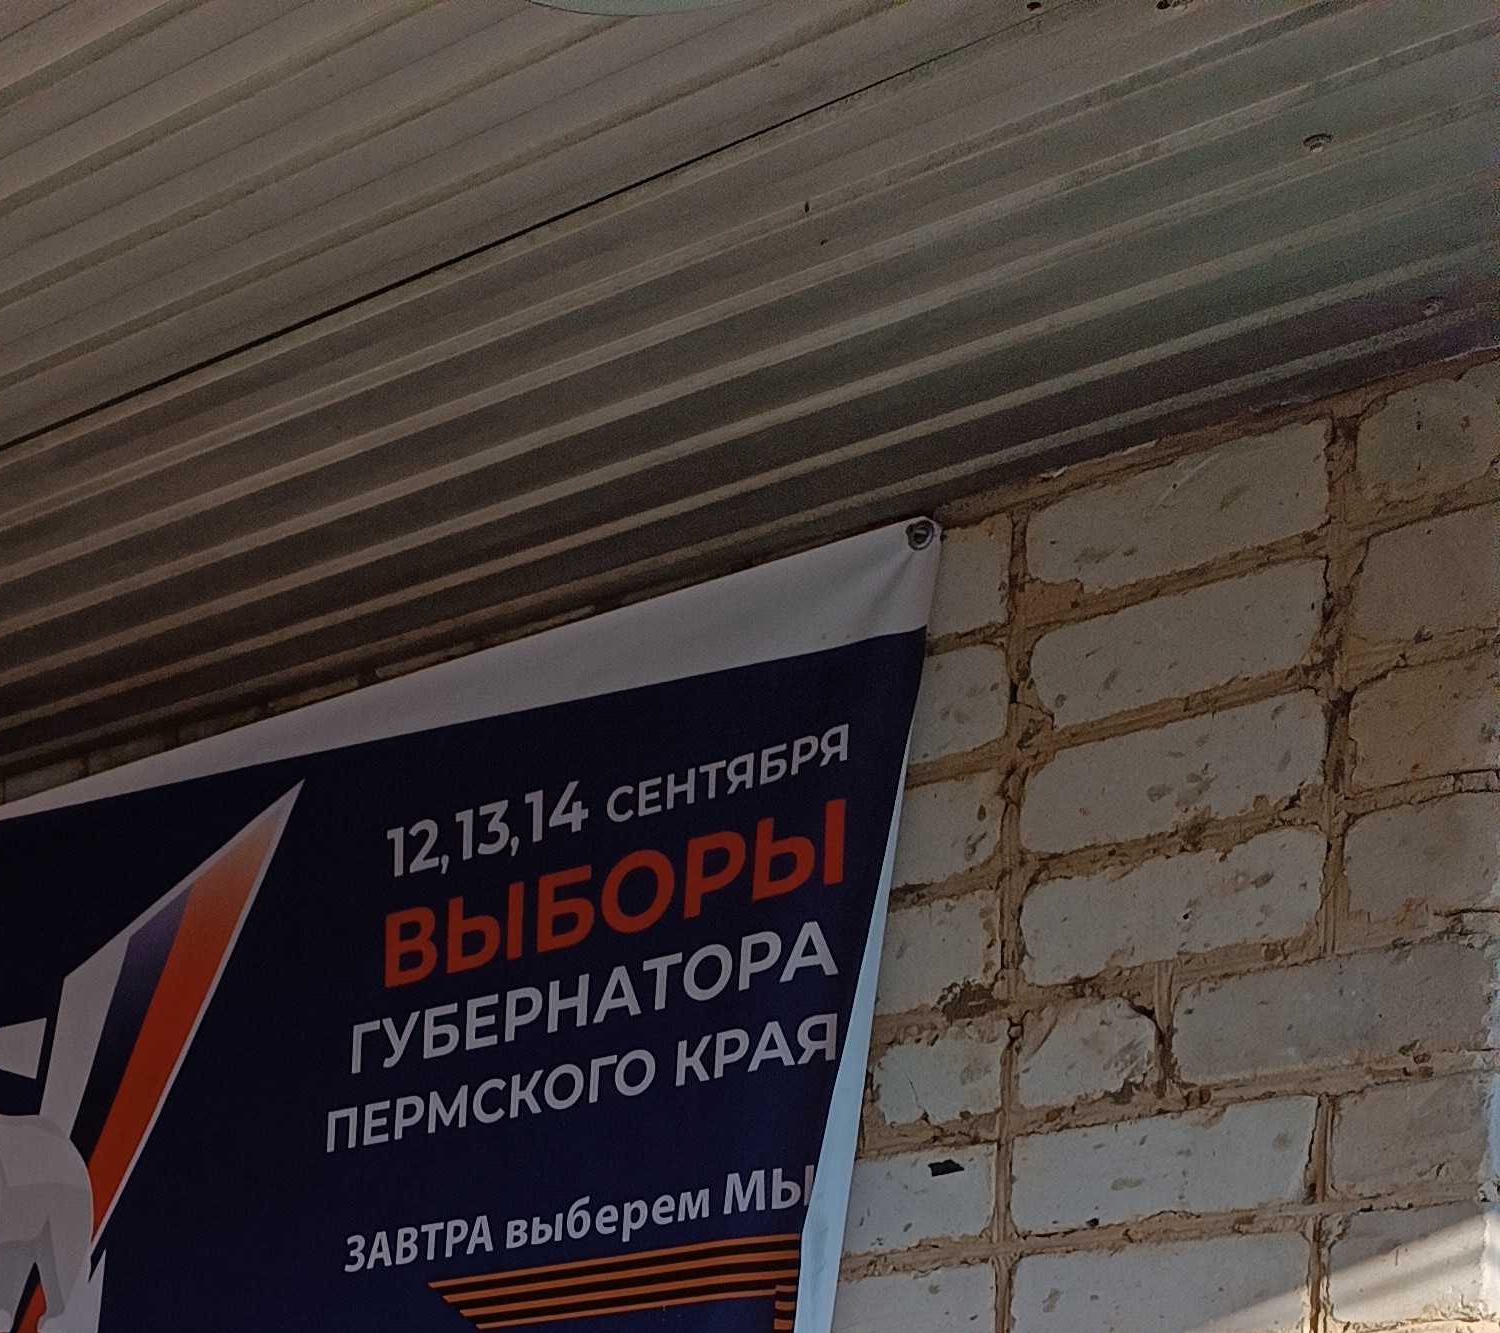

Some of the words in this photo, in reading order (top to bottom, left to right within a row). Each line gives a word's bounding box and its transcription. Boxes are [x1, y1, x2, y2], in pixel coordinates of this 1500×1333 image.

[387, 781, 589, 877] 12,13,14
[606, 724, 850, 823] СЕНТЯБРЯ
[384, 800, 846, 988] ВЫБОРЫ
[351, 921, 840, 1074] ГУБЕРНАТОРА
[325, 1049, 656, 1152] ПЕРМСКОГО
[675, 1013, 839, 1087] КРАЯ
[344, 1214, 494, 1272] ЗАВТРА
[505, 1188, 710, 1249] выберем
